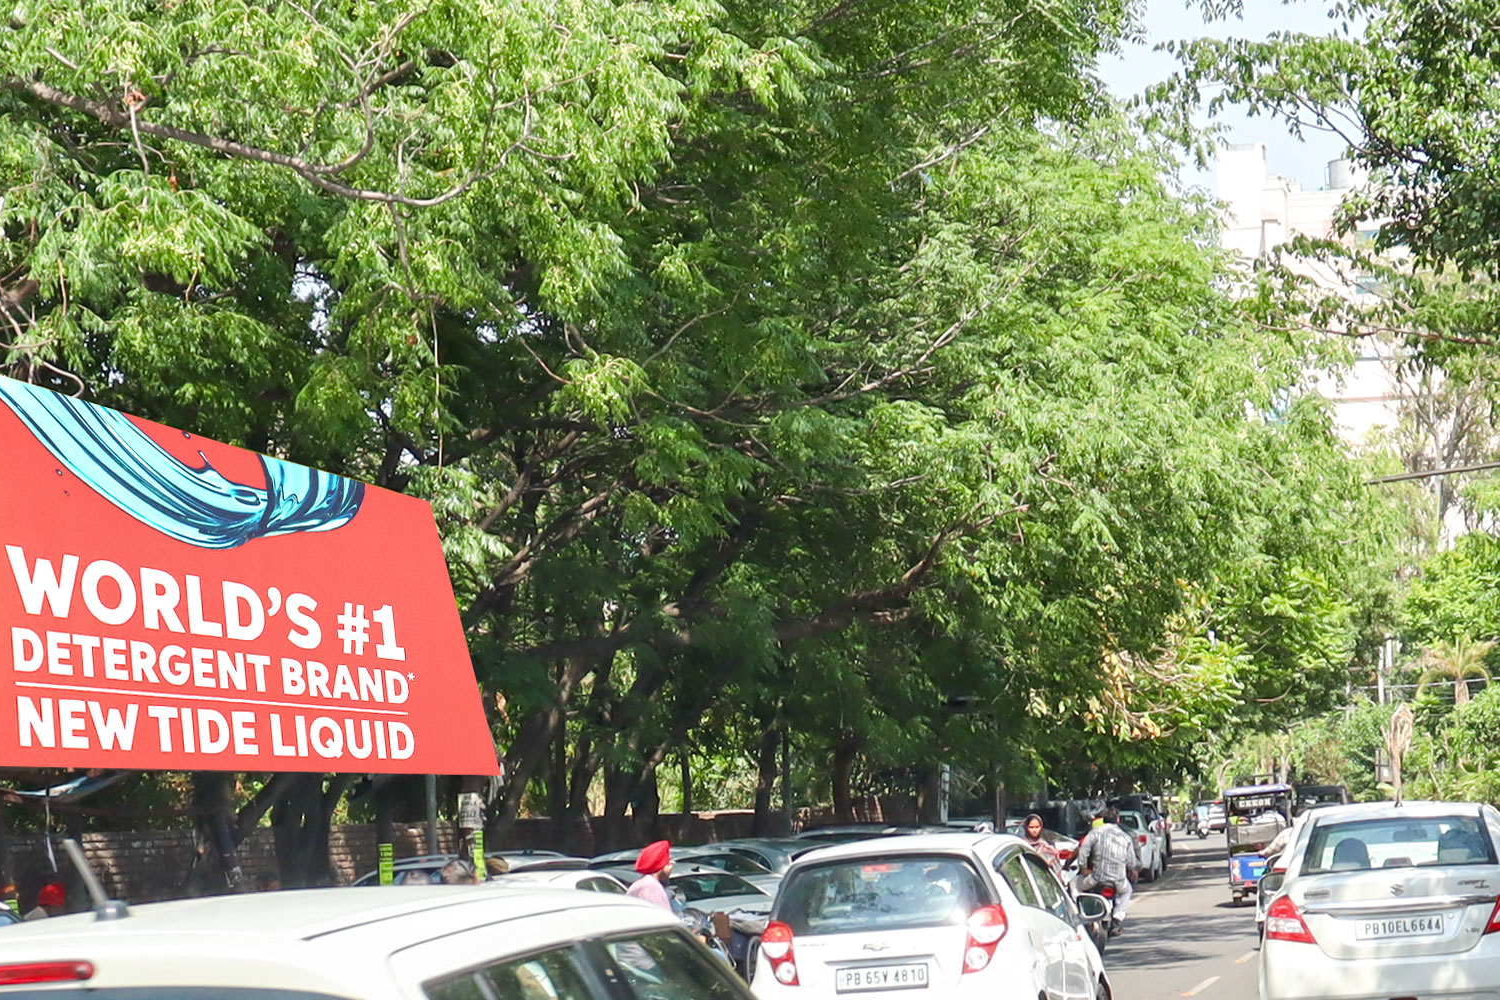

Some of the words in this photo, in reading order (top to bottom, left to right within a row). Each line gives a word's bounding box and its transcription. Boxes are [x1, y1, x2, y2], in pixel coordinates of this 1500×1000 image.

[5, 544, 323, 650] WORLD'S
[337, 601, 406, 661] #1
[11, 627, 273, 692] DETERGENT
[16, 696, 140, 751] NEW
[148, 705, 261, 758] TIDE
[269, 713, 416, 760] LIQUID
[1365, 918, 1442, 936] PB10EL6644
[845, 972, 861, 986] PB
[893, 968, 925, 983] 4810
